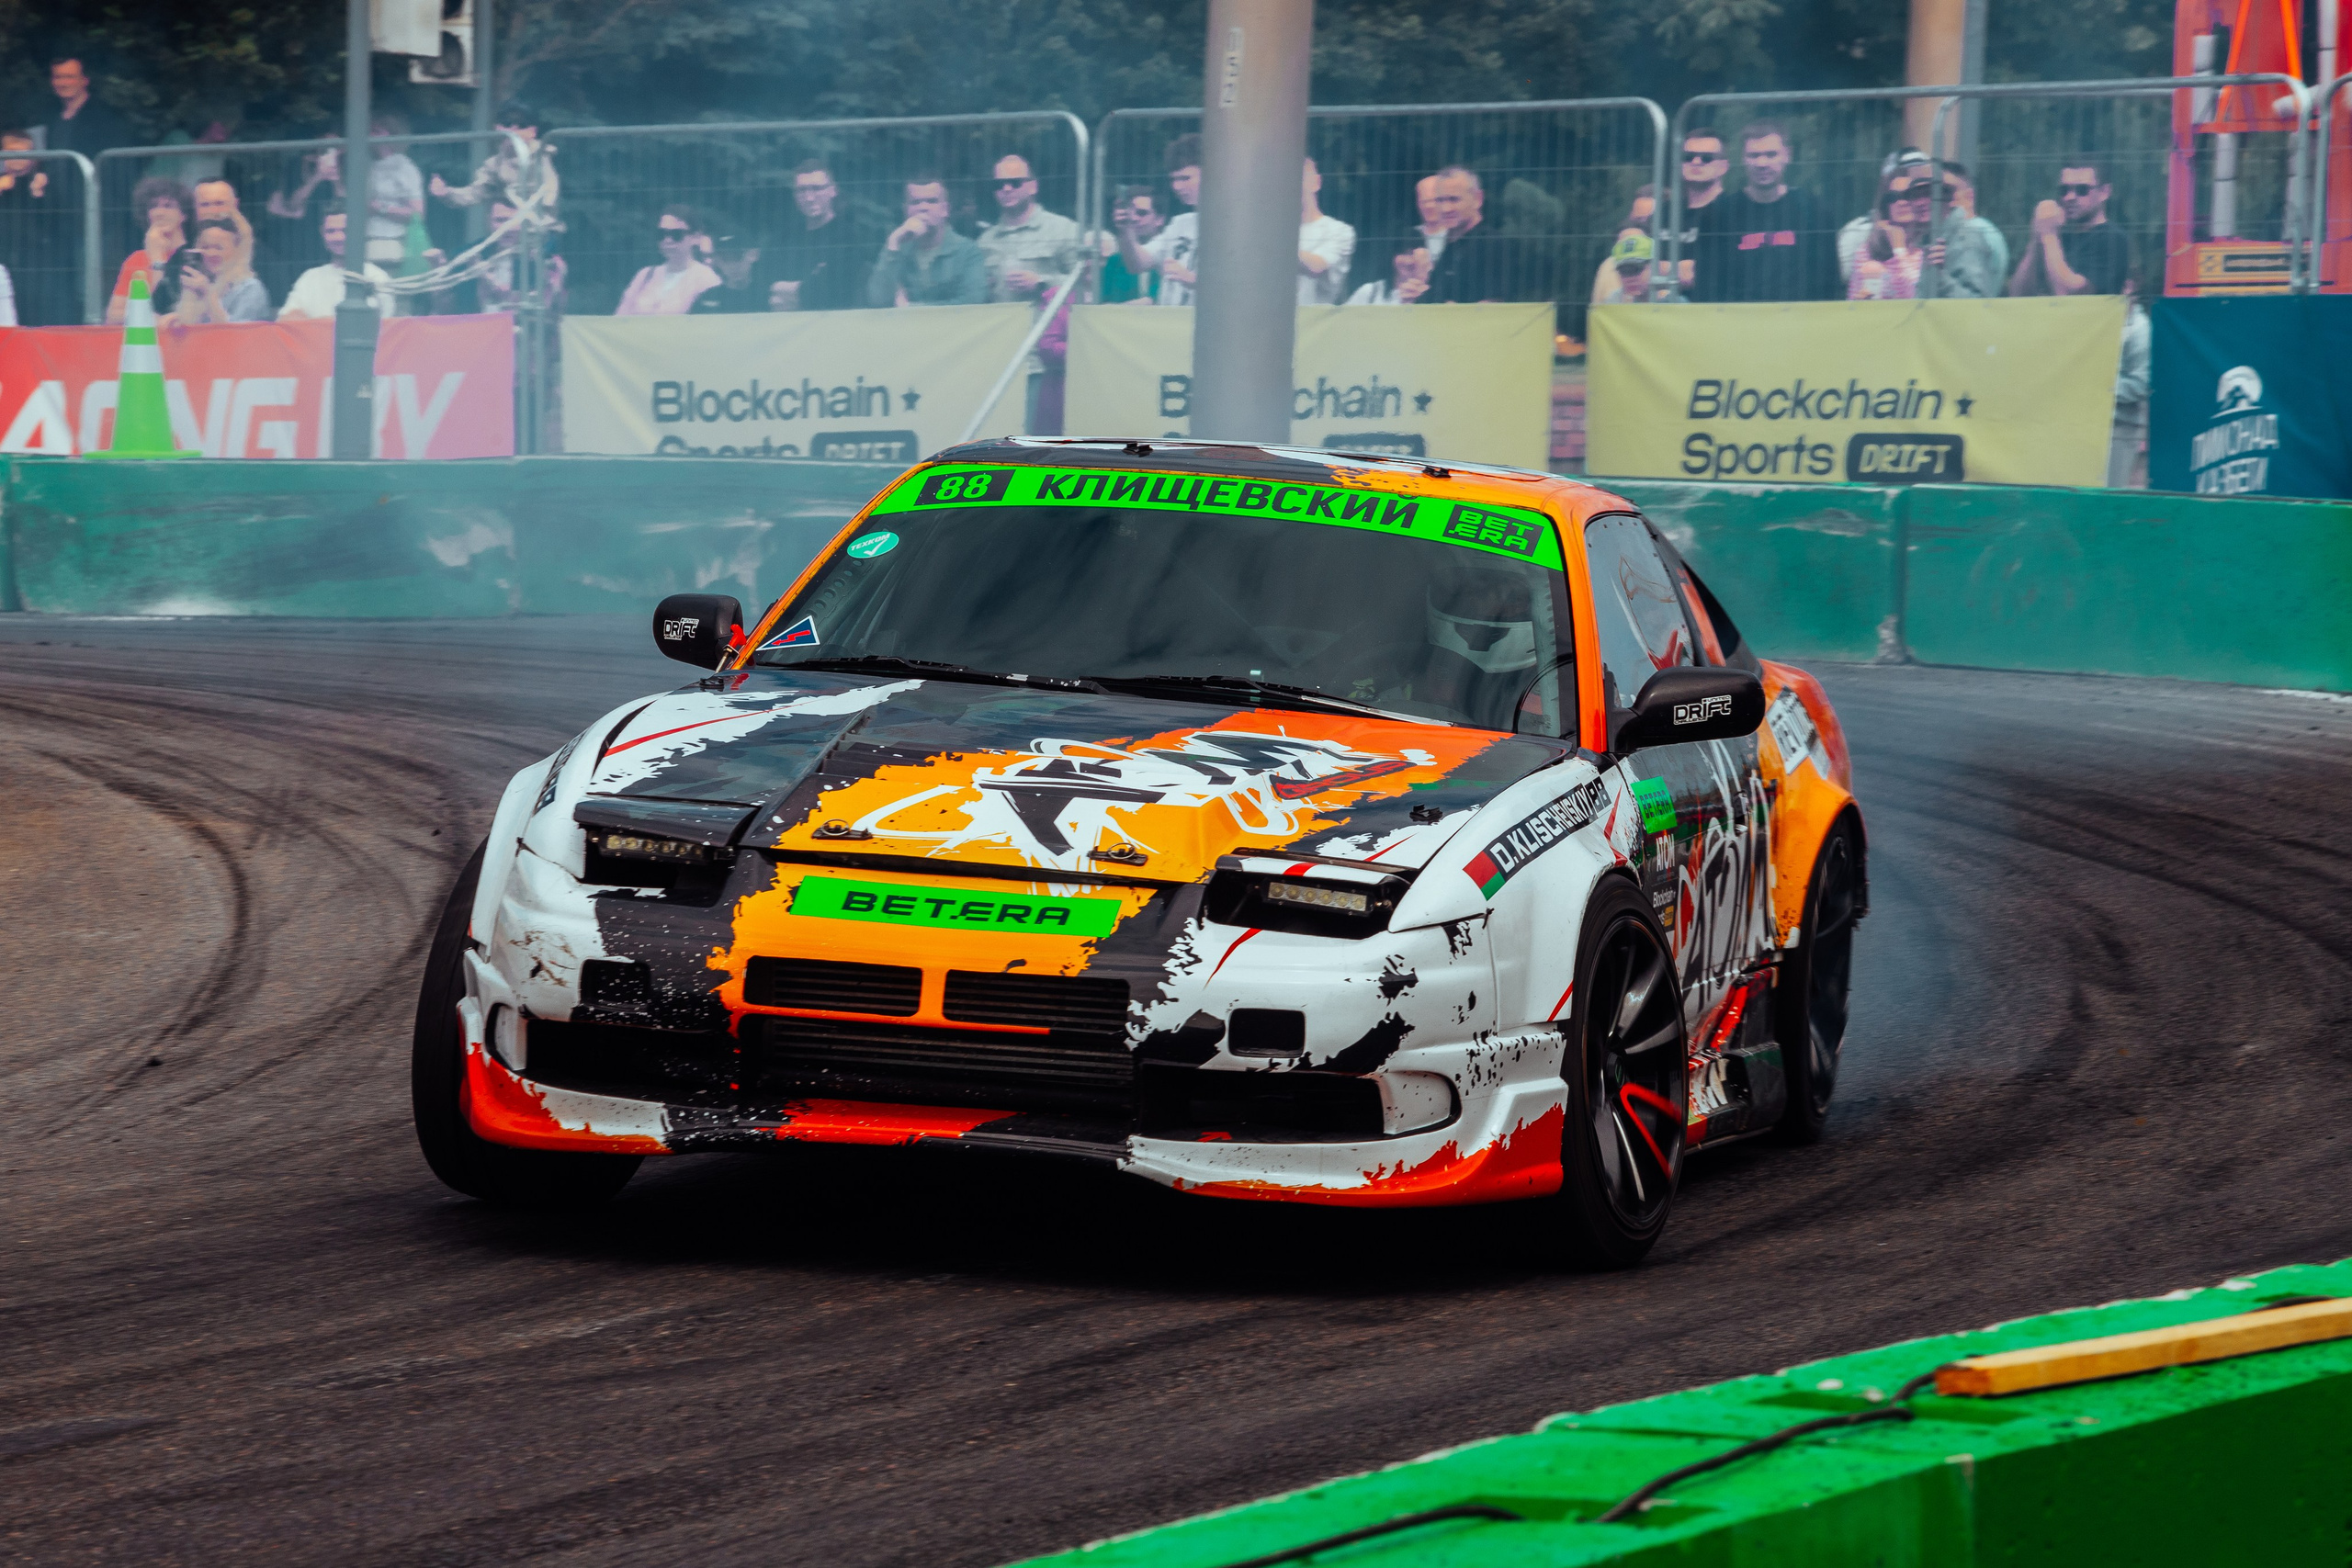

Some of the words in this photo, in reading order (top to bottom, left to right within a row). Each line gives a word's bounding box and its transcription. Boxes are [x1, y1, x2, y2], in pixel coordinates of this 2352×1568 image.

[652, 376, 889, 423] Blockchain
[1159, 374, 1402, 418] Bchain
[1688, 378, 1943, 421] Blockchain
[1681, 432, 1835, 479] Sports
[1857, 443, 1951, 474] DRIFT
[934, 474, 992, 501] 88
[1035, 474, 1420, 530] КЛИЩЕВСКИЙ
[1458, 509, 1534, 536] BET
[1656, 833, 1675, 872] ATOM
